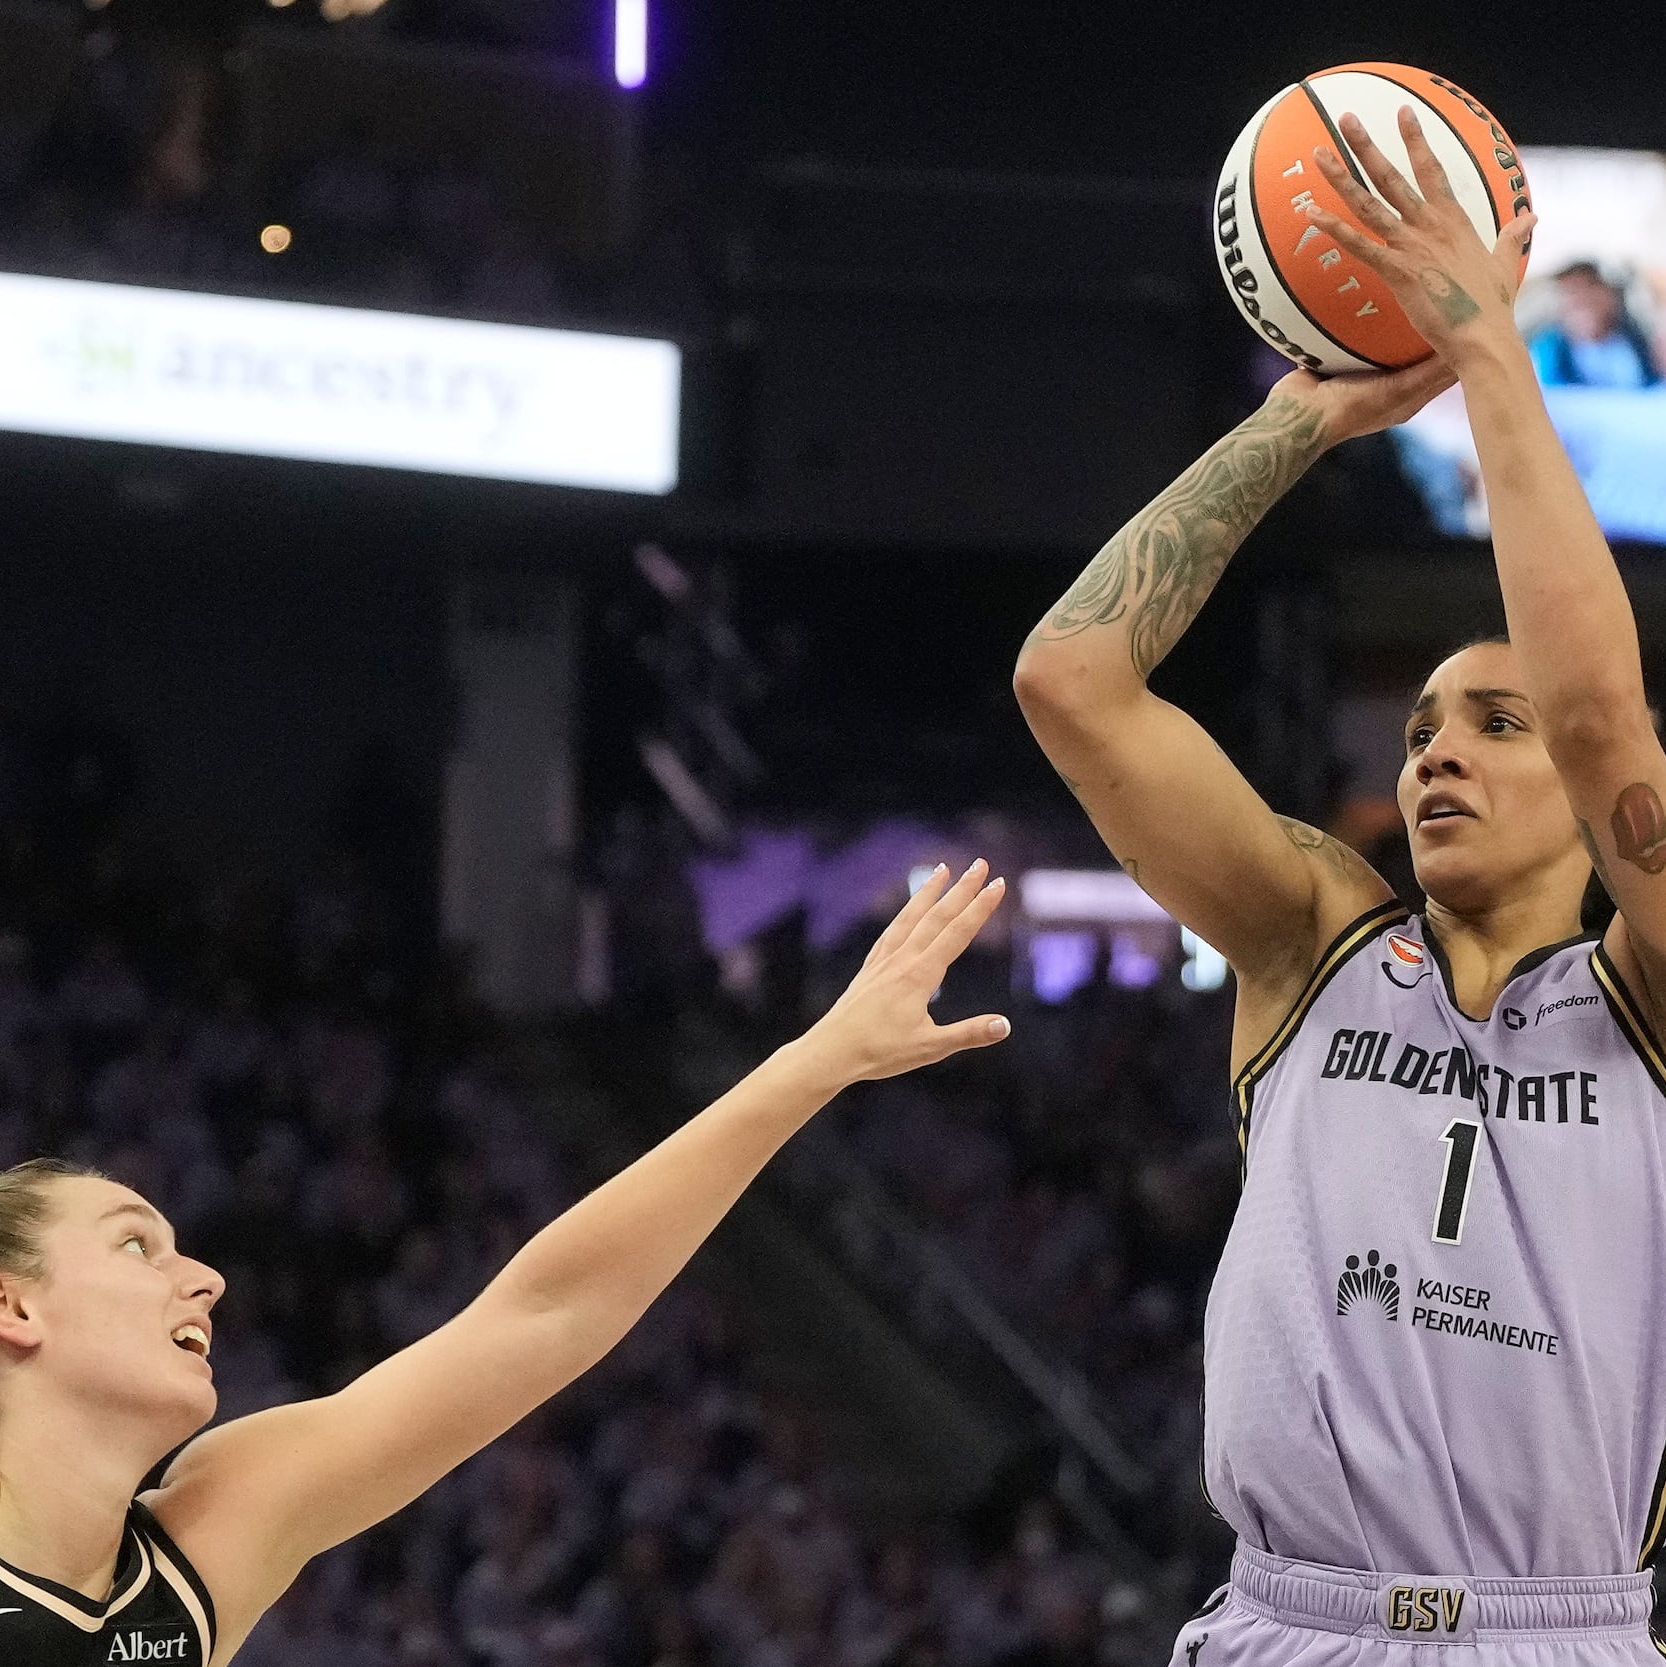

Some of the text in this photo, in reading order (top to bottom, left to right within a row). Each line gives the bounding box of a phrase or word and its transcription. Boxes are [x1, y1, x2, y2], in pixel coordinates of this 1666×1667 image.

[160, 334, 535, 452] ancestry
[1534, 995, 1599, 1027] freedom
[1320, 1027, 1599, 1126] GOLDEN STATE
[1431, 1117, 1483, 1246] 1
[1416, 1278, 1491, 1311] KAISER
[1411, 1306, 1560, 1356] PERMANENTE
[1388, 1585, 1466, 1633] GSV
[107, 1631, 188, 1662] Albert
